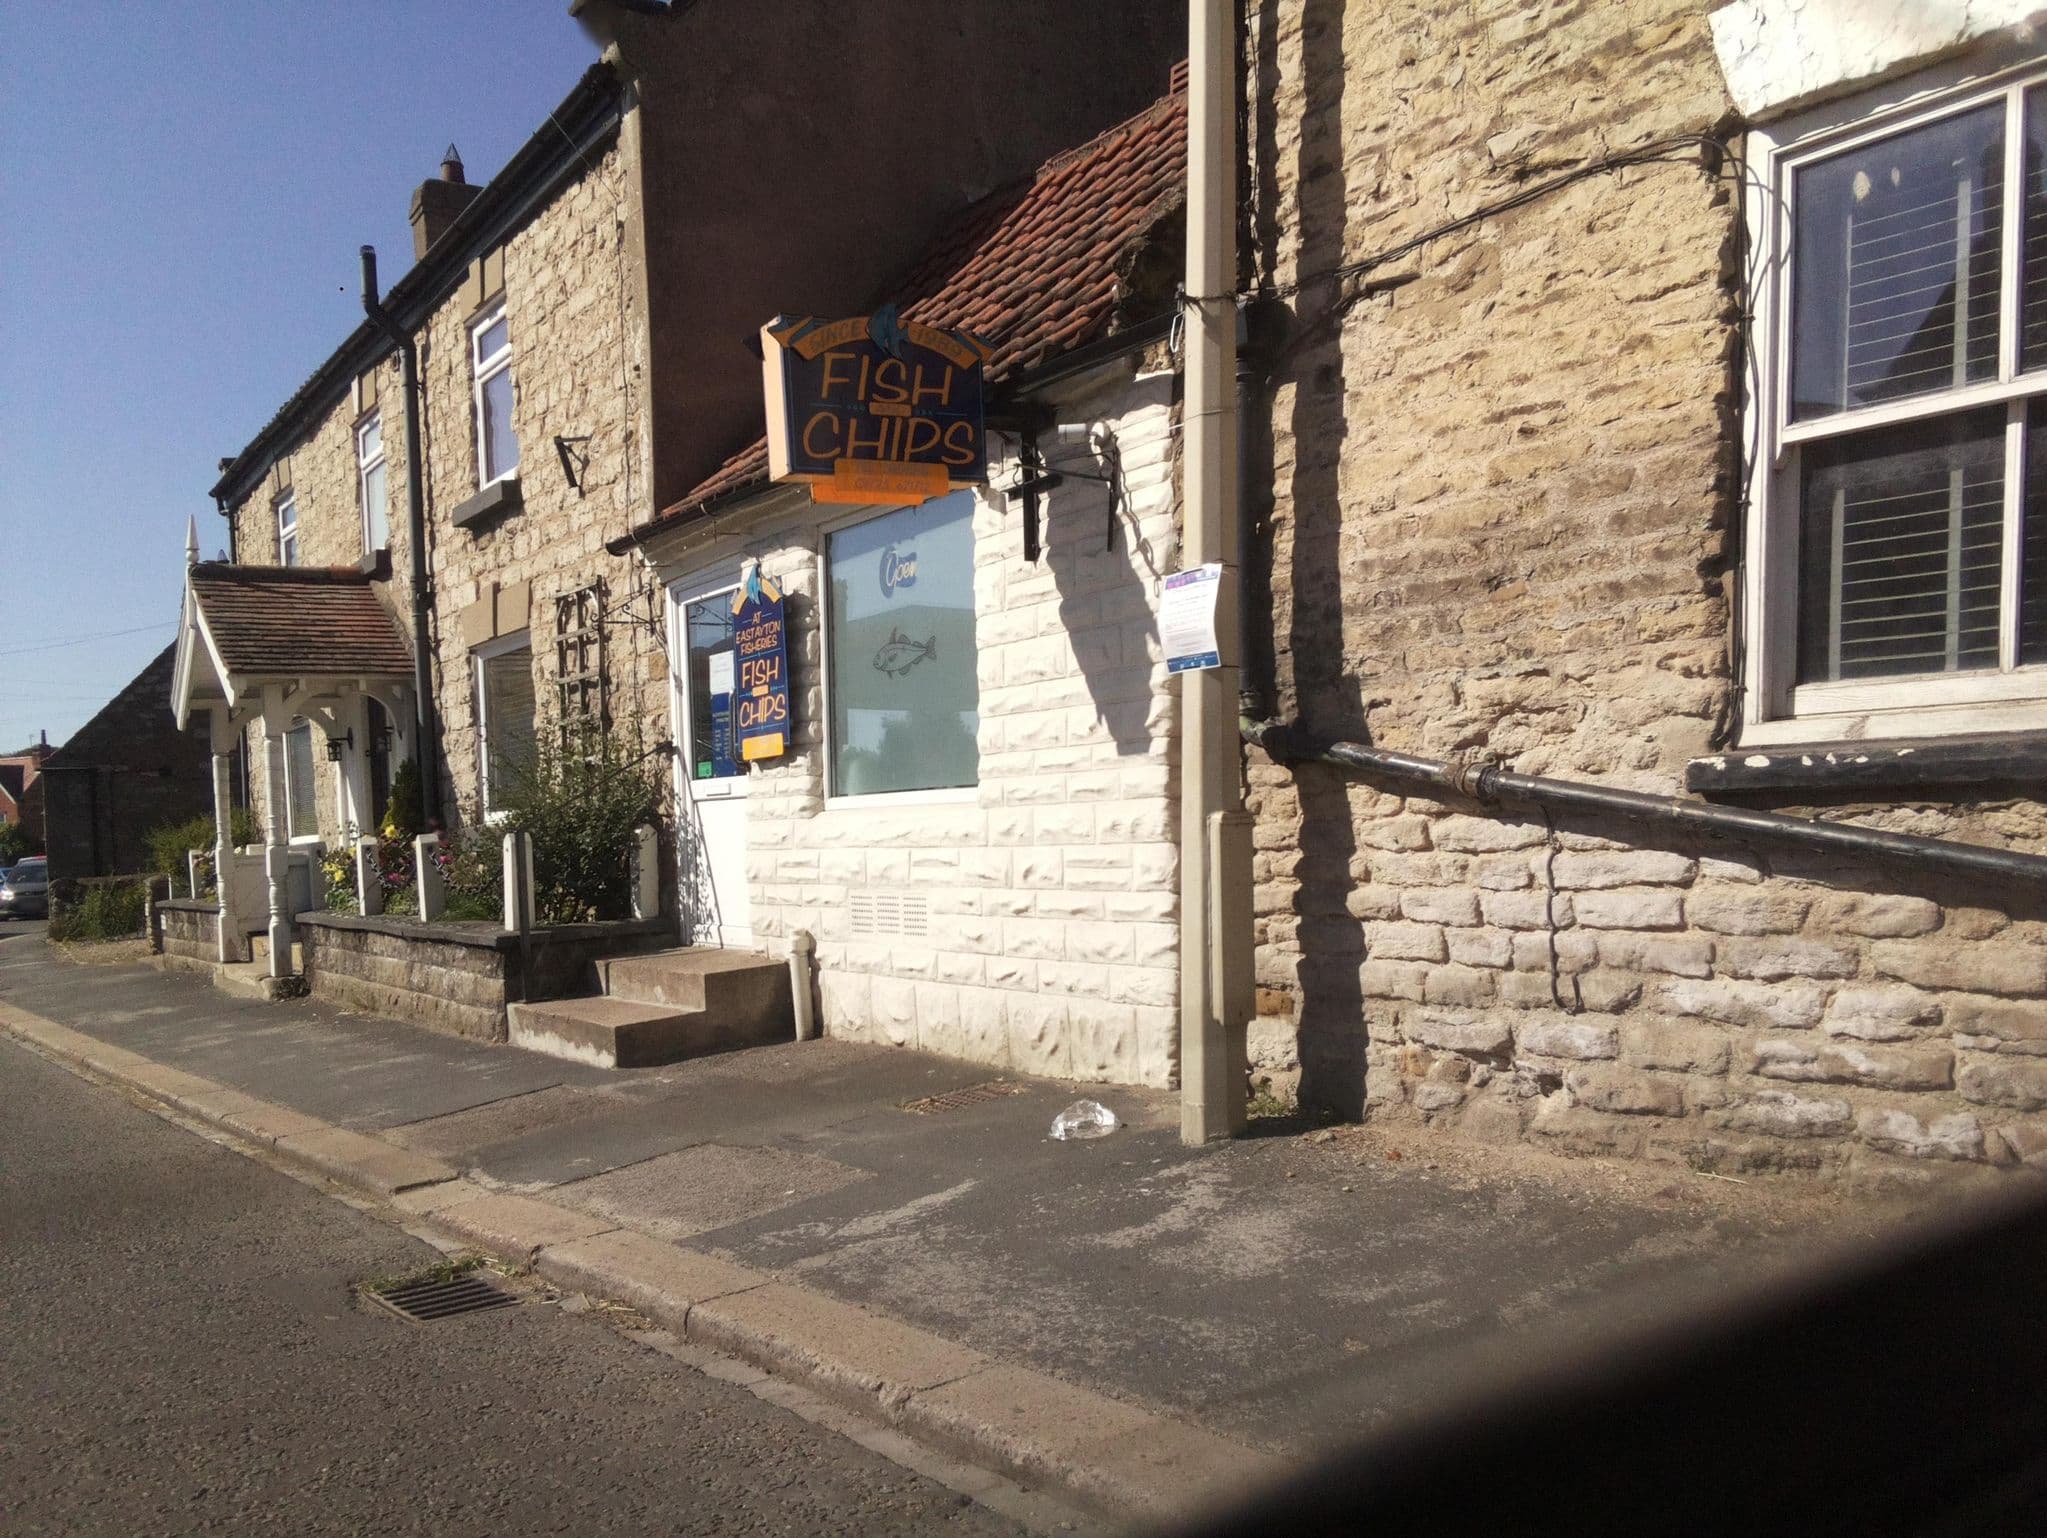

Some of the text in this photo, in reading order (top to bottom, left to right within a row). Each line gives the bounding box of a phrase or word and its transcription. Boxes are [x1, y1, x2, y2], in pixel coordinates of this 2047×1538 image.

[821, 352, 952, 406] FISH
[803, 411, 976, 465] CHIPS
[886, 550, 918, 588] Open
[751, 611, 762, 625] AT
[740, 634, 778, 656] FISHERIES
[742, 656, 779, 688] FISH
[739, 693, 787, 728] CHIPS
